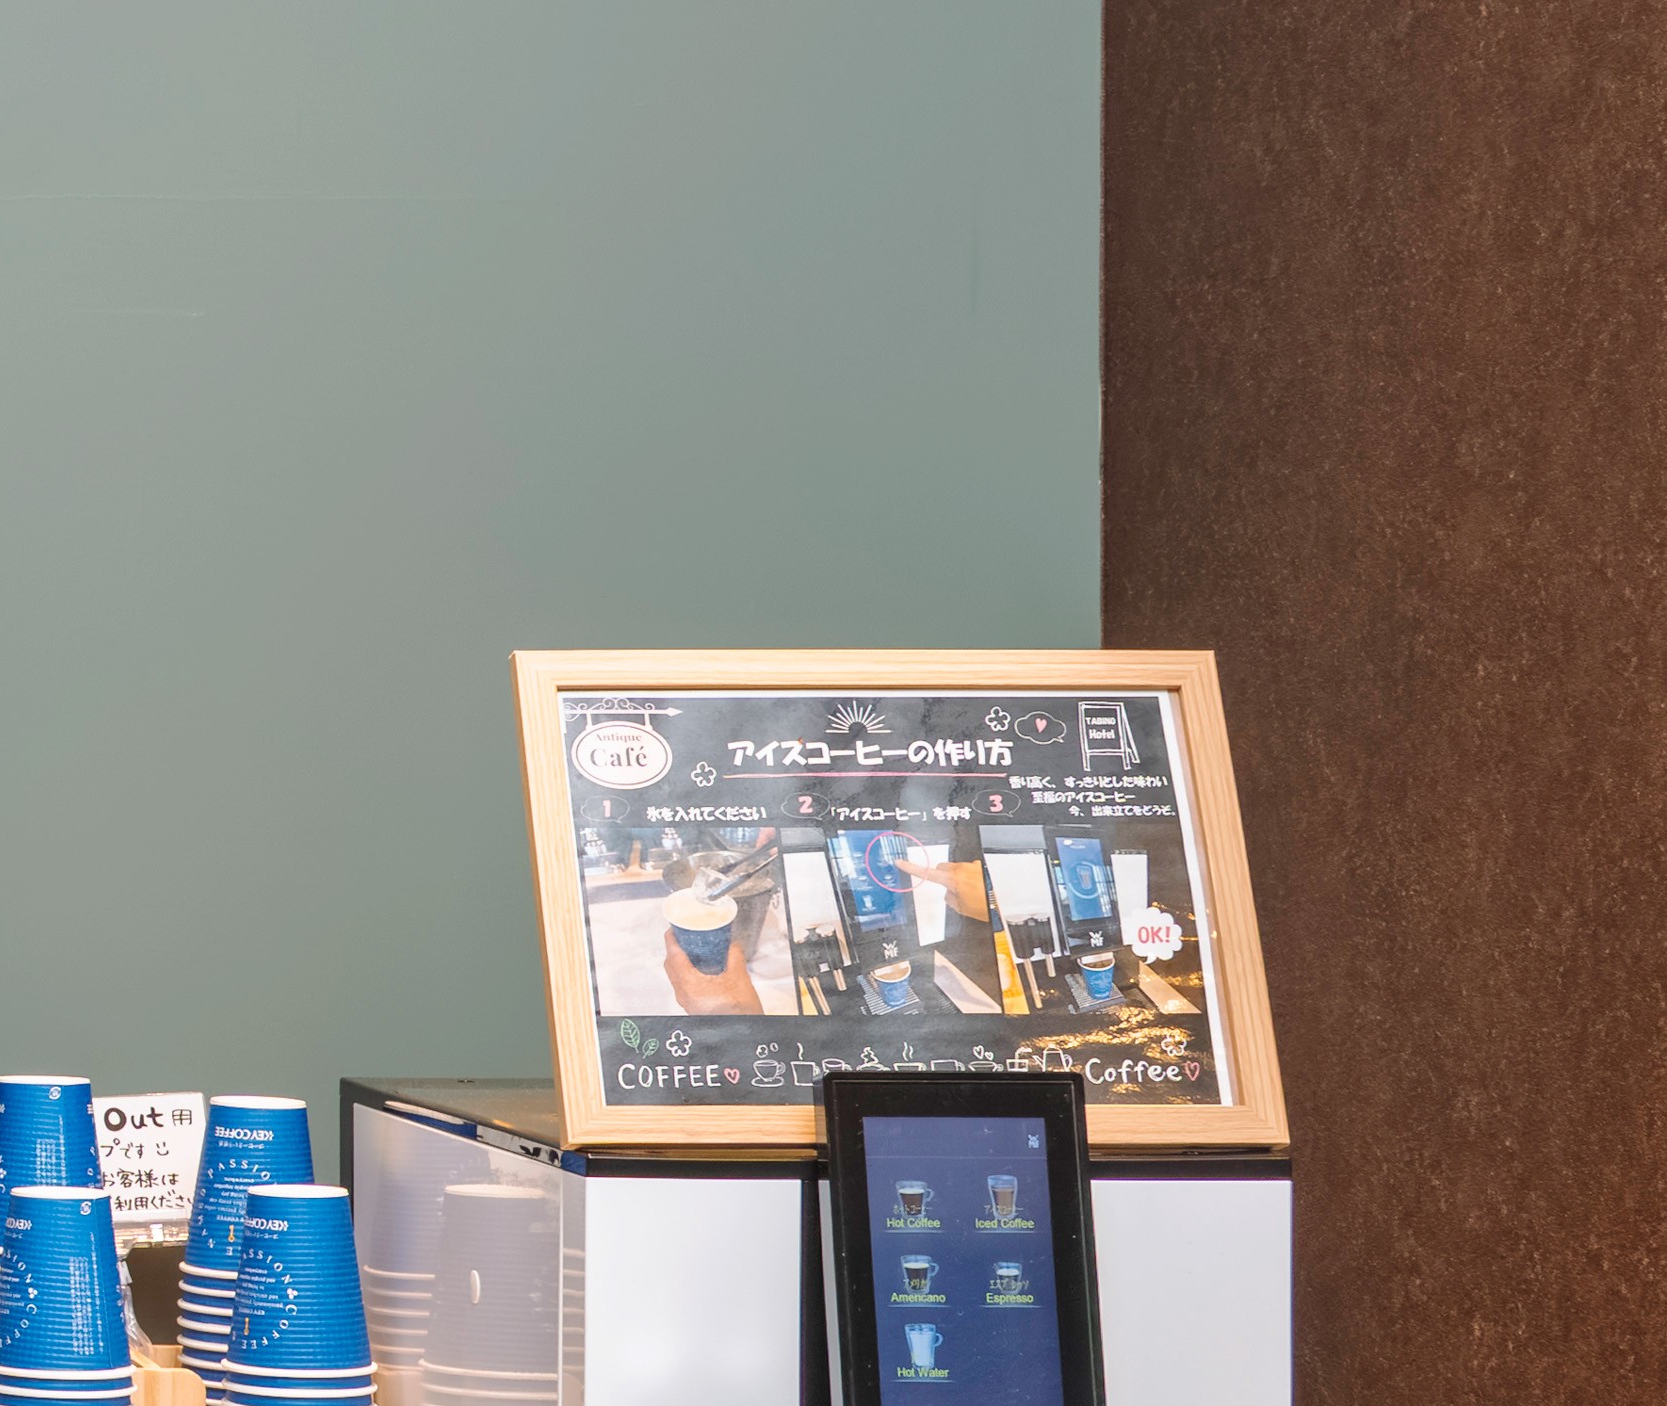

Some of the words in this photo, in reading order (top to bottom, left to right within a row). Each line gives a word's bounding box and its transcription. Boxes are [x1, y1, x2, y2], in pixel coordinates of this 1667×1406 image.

[1086, 716, 1116, 726] TABINO
[595, 733, 642, 744] Antique
[1089, 728, 1115, 740] Hotel
[590, 746, 647, 769] Café
[727, 739, 1014, 767] アイスコーヒーの作り方
[602, 800, 611, 818] 1
[798, 796, 813, 814] 2
[989, 795, 1003, 813] 3
[646, 806, 767, 821] 氷を入れてください
[1137, 926, 1171, 945] OK!
[618, 1063, 722, 1090] COFFEE
[1085, 1059, 1183, 1085] Coffee
[104, 1106, 164, 1132] Out
[171, 1108, 193, 1126] 用
[100, 1138, 145, 1159] プです
[102, 1167, 179, 1188] お客様は
[886, 1217, 905, 1228] Hot
[907, 1217, 941, 1228] Coffee
[975, 1217, 998, 1229] Iced
[1000, 1217, 1036, 1229] Coffee
[890, 1292, 947, 1303] Americano
[986, 1292, 1034, 1305] Espresso
[897, 1367, 915, 1378] Hot
[916, 1367, 949, 1378] Water
